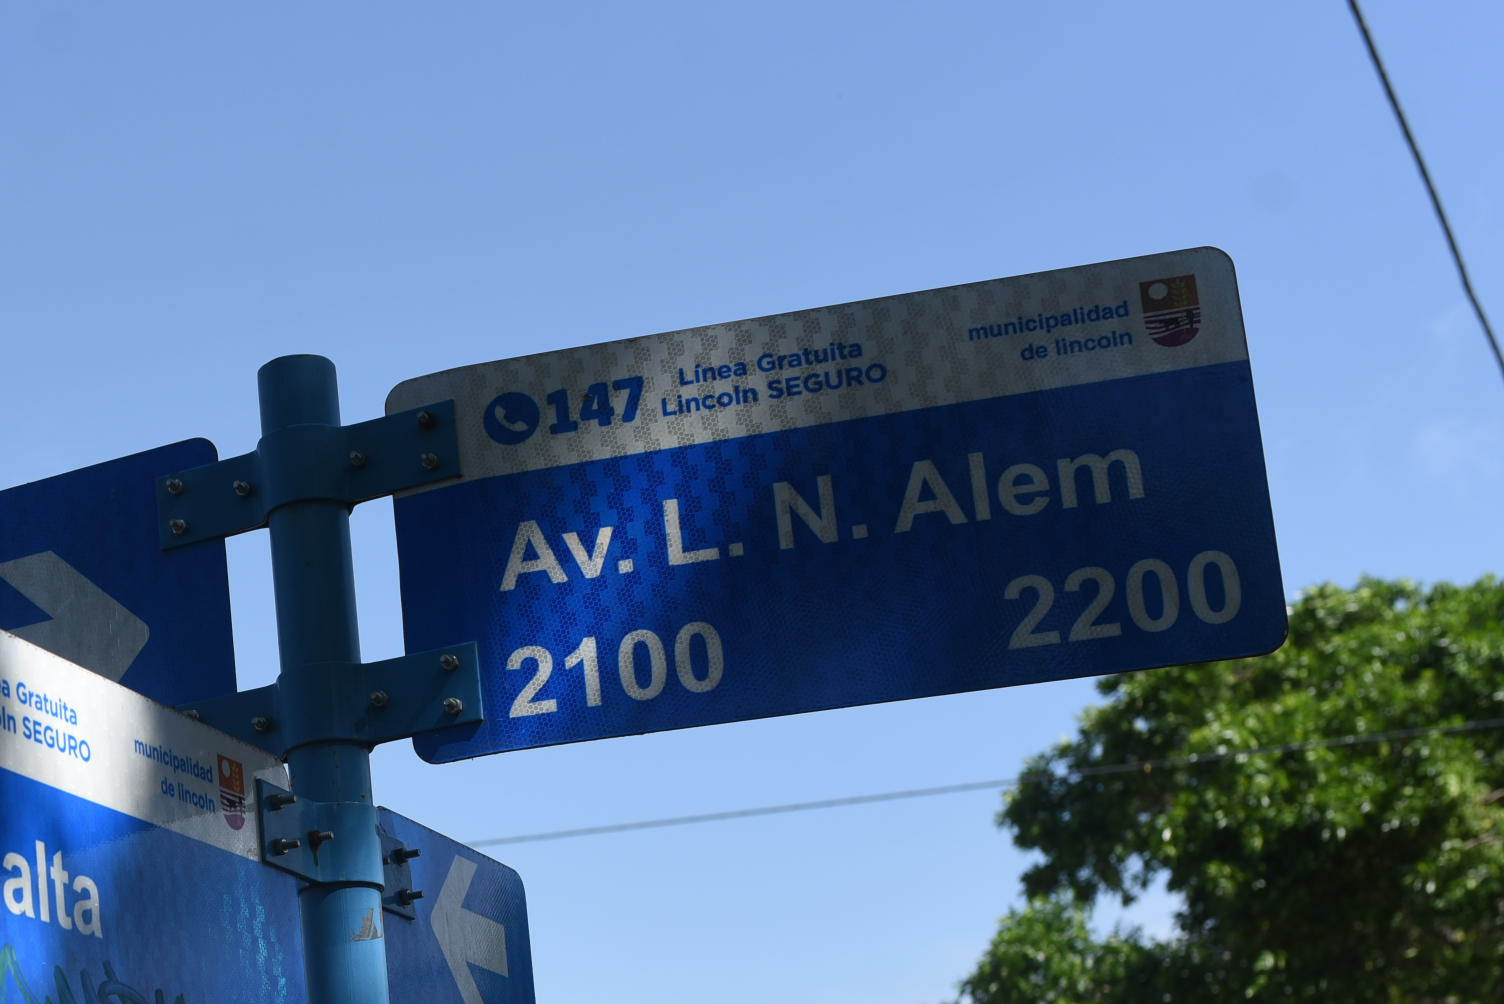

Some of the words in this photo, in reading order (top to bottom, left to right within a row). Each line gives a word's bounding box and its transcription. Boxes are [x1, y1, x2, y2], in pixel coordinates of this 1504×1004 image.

[968, 301, 1129, 341] municipalidad
[678, 359, 748, 387] Línea
[757, 342, 863, 373] Gratuita
[1021, 344, 1048, 361] de
[1056, 331, 1133, 356] lincoln
[546, 376, 644, 435] 147
[661, 384, 759, 417] Lincoln
[767, 363, 888, 400] SEGURO
[499, 520, 634, 592] Av.
[663, 498, 744, 566] L.
[772, 474, 868, 551] N.
[896, 447, 1145, 533] Alem
[1003, 549, 1242, 651] 2200
[505, 621, 725, 718] 2100
[16, 682, 78, 726] Gratuita
[22, 716, 91, 763] SEGURO
[134, 739, 213, 784] municipalidad
[160, 776, 175, 798] de
[178, 783, 216, 813] lincoln
